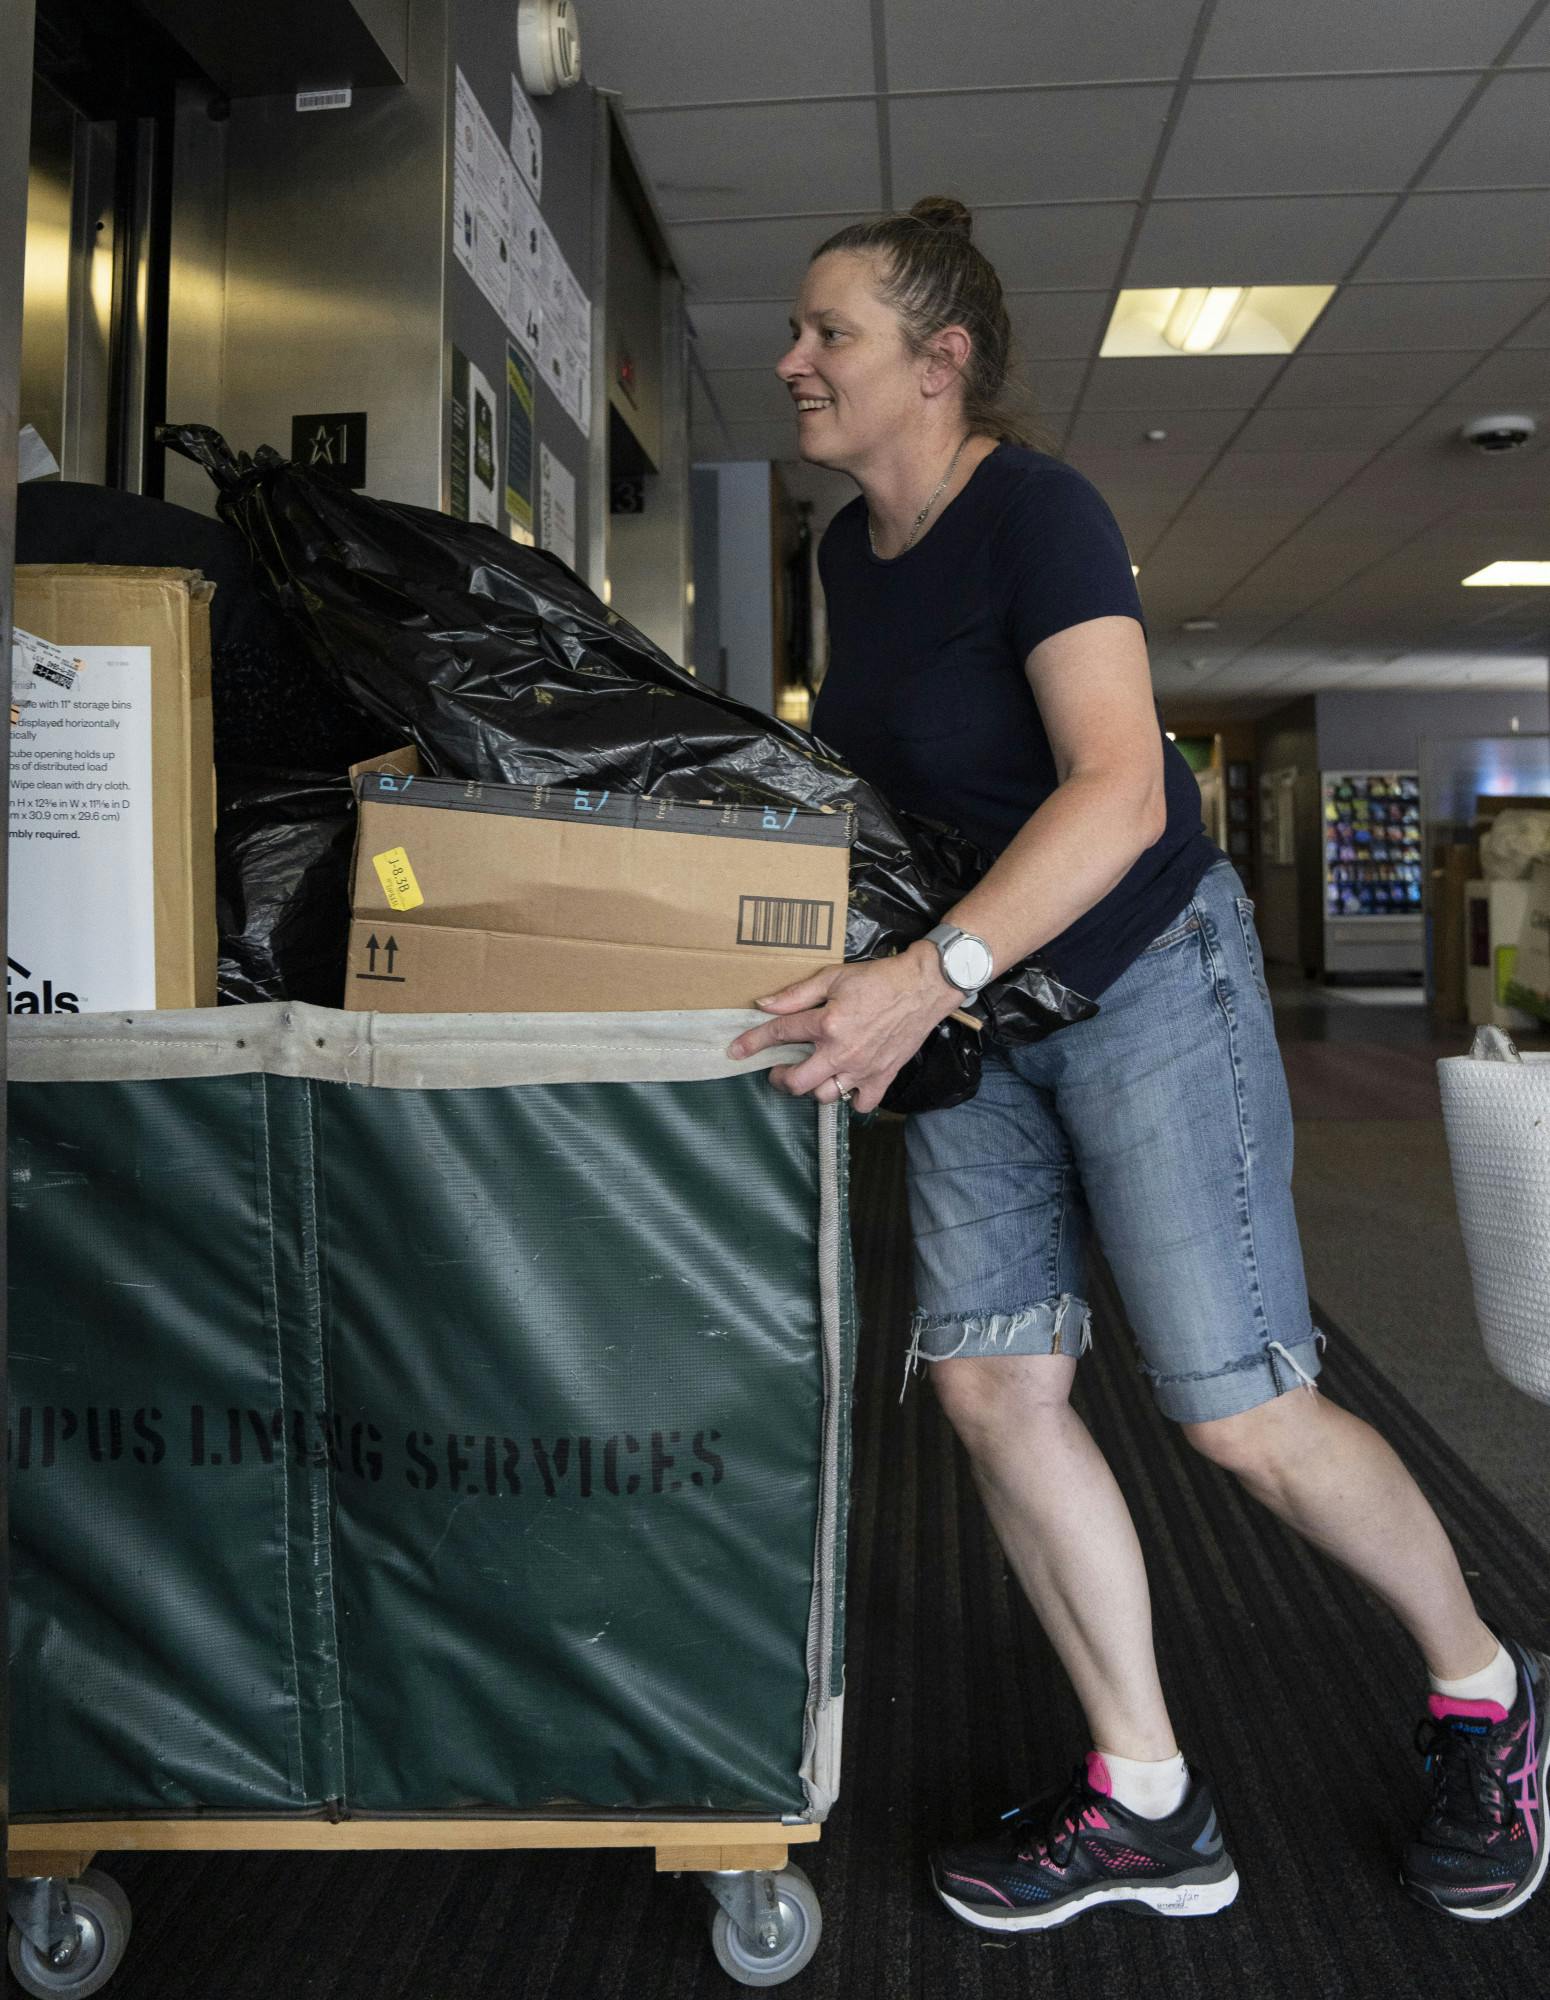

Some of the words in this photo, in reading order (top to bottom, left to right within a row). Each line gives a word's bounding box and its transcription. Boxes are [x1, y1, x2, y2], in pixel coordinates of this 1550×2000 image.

[40, 700, 58, 709] with
[73, 701, 110, 711] storage
[112, 701, 132, 709] bins
[18, 719, 63, 728] displayed
[65, 719, 120, 728] horizontally
[34, 750, 73, 760] opening
[74, 751, 101, 759] holds
[22, 761, 32, 770] of
[34, 762, 85, 771] distributed
[87, 763, 108, 771] load
[11, 780, 35, 790] Wipe
[37, 781, 62, 789] clean
[64, 782, 84, 790] with
[86, 782, 102, 791] dry
[104, 782, 131, 791] cloth.
[17, 799, 25, 807] H
[59, 800, 68, 808] in
[69, 800, 80, 808] W
[112, 800, 120, 809] in
[122, 800, 130, 809] D
[29, 811, 51, 820] 30.9
[53, 813, 69, 821] cm
[78, 812, 99, 821] 29.6
[102, 812, 120, 822] cm)
[35, 831, 80, 840] required.
[190, 1405, 384, 1482] LIVING
[405, 1429, 725, 1498] SERVICES
